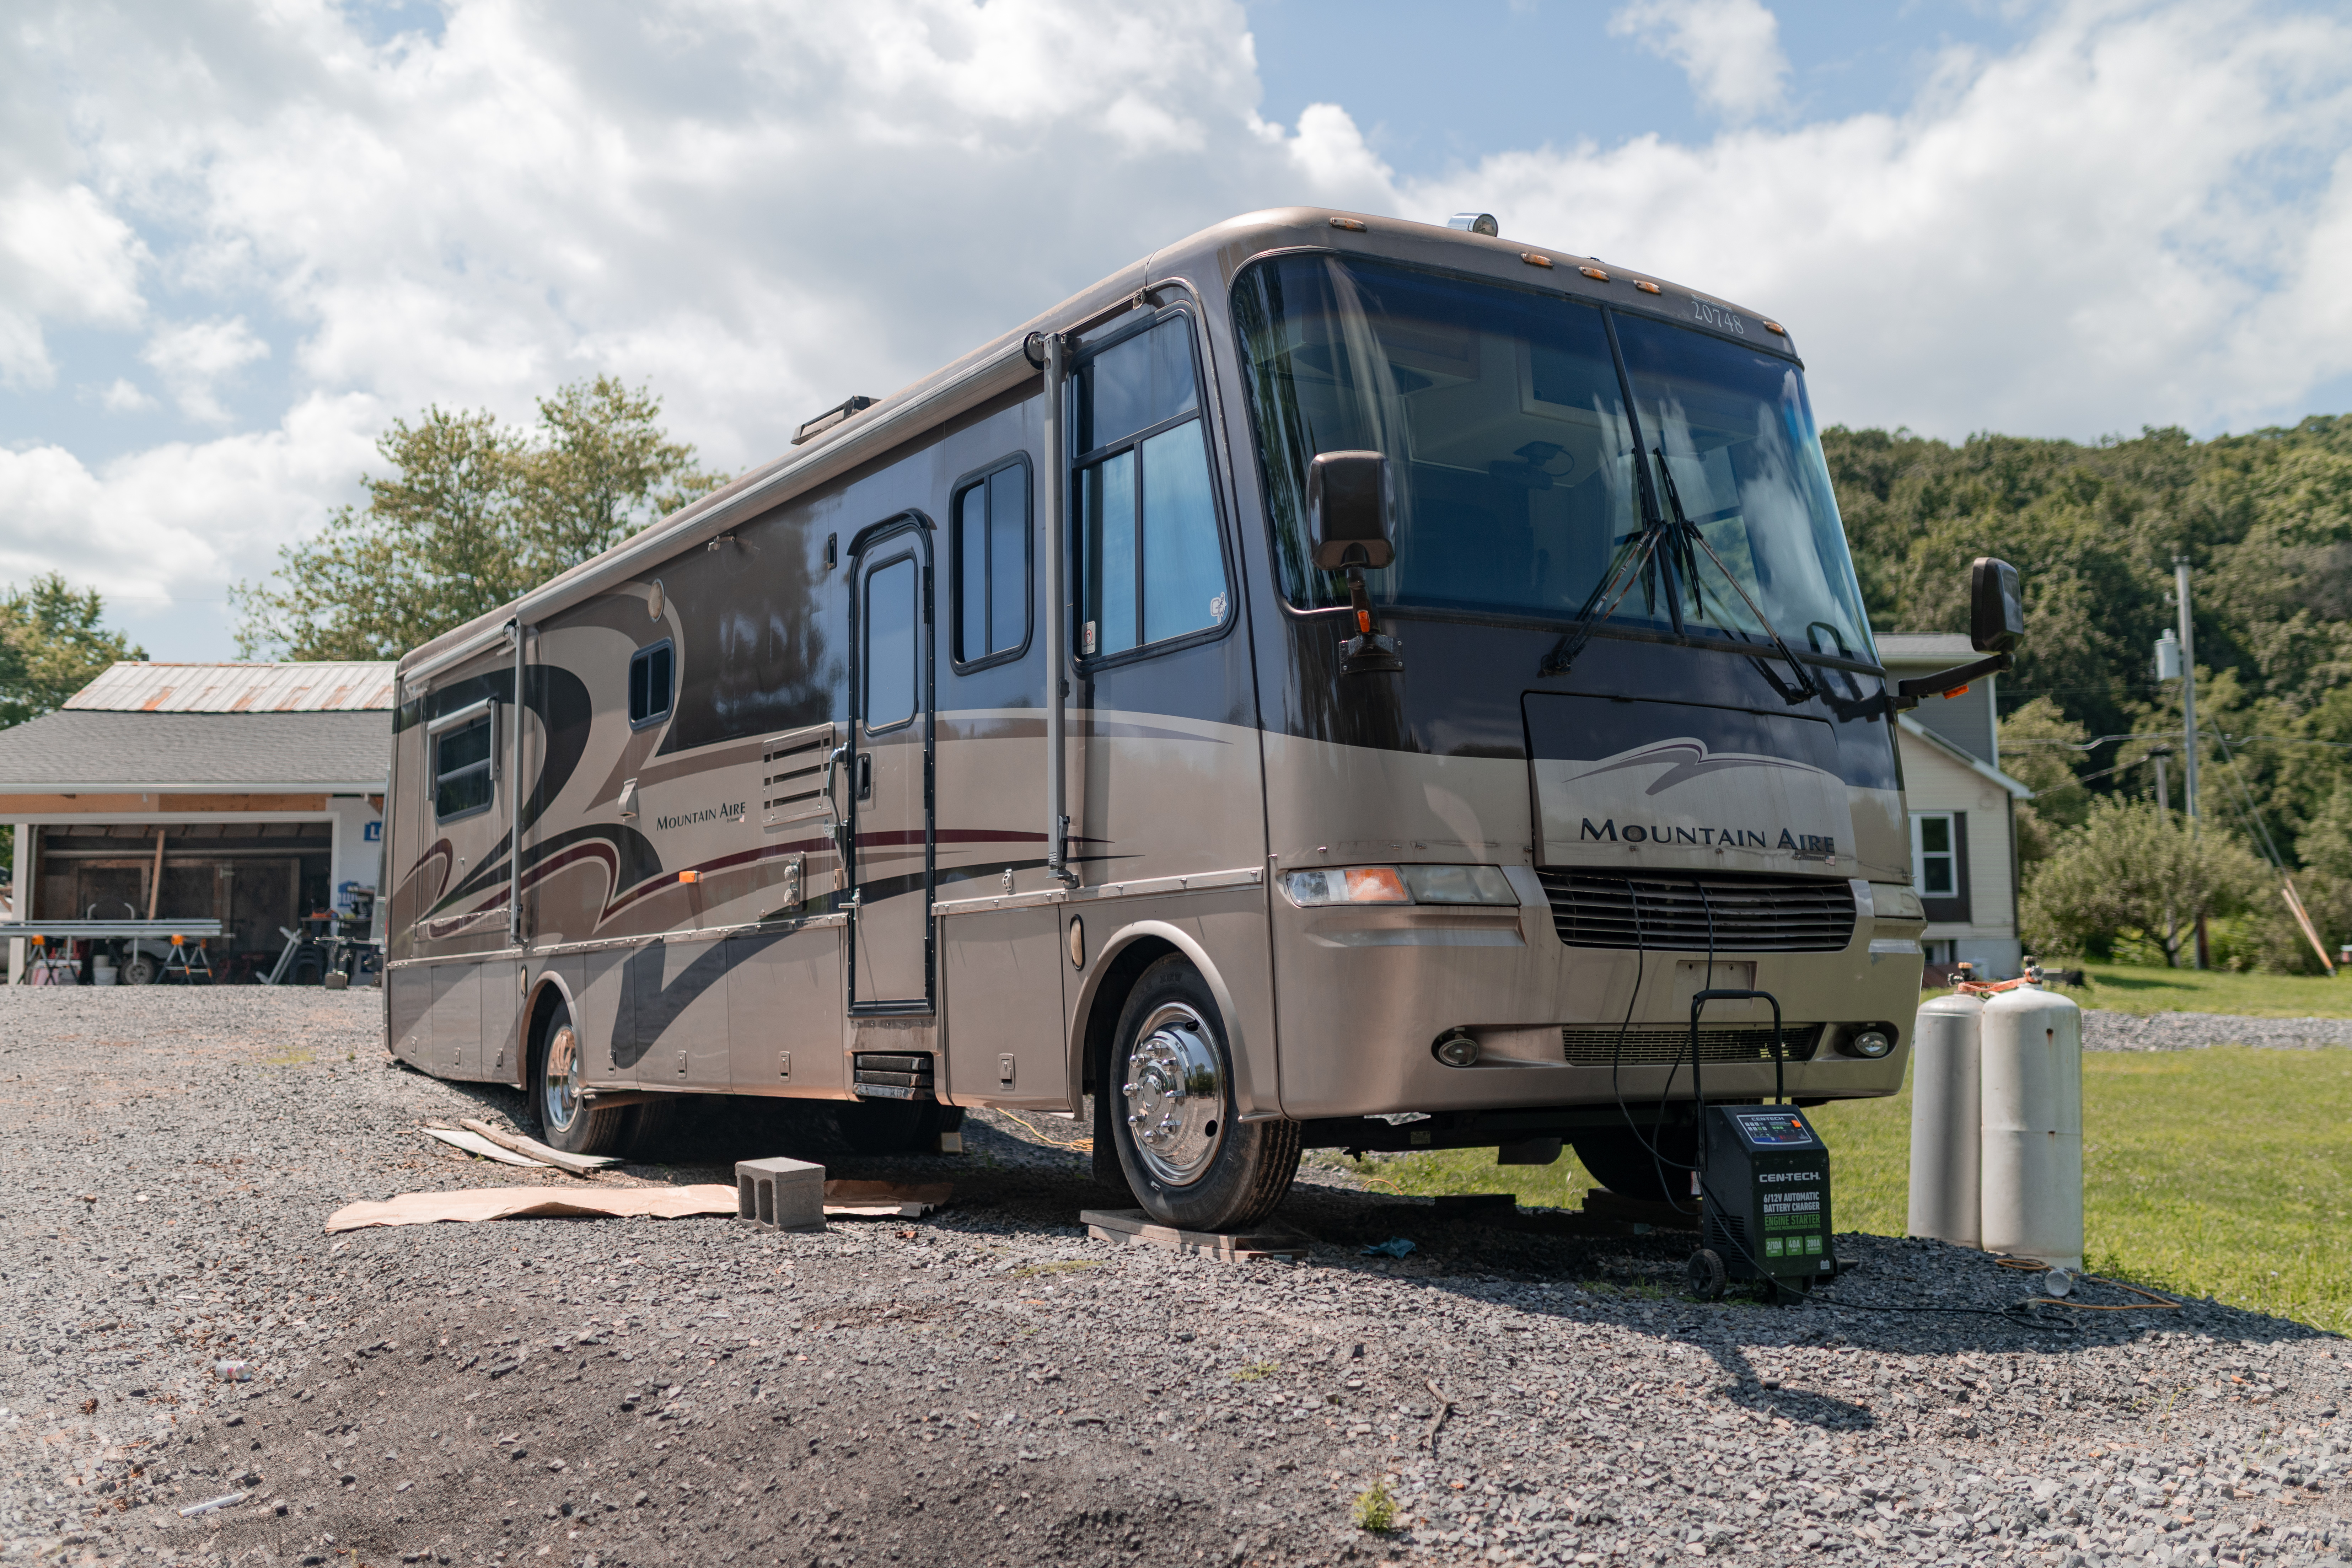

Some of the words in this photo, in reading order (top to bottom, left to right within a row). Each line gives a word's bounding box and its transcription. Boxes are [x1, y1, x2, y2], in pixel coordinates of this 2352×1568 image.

[1691, 301, 1744, 334] 20748
[657, 808, 716, 831] MOUNTAIN
[720, 802, 746, 818] AIRE
[1580, 818, 1766, 848] MOUNTAIN
[1777, 828, 1835, 853] AIRE
[1159, 972, 1182, 984] XRV
[1763, 1193, 1782, 1203] 6/12V
[1784, 1192, 1819, 1202] AUTOMATIC
[1763, 1203, 1790, 1213] BATTERY
[1792, 1202, 1820, 1211] CHARGER
[1765, 1215, 1789, 1226] ENGINE
[1791, 1214, 1820, 1225] STARTER
[1767, 1241, 1782, 1250] 2/10A
[1789, 1240, 1800, 1248] 40A
[1807, 1239, 1820, 1247] 200A
